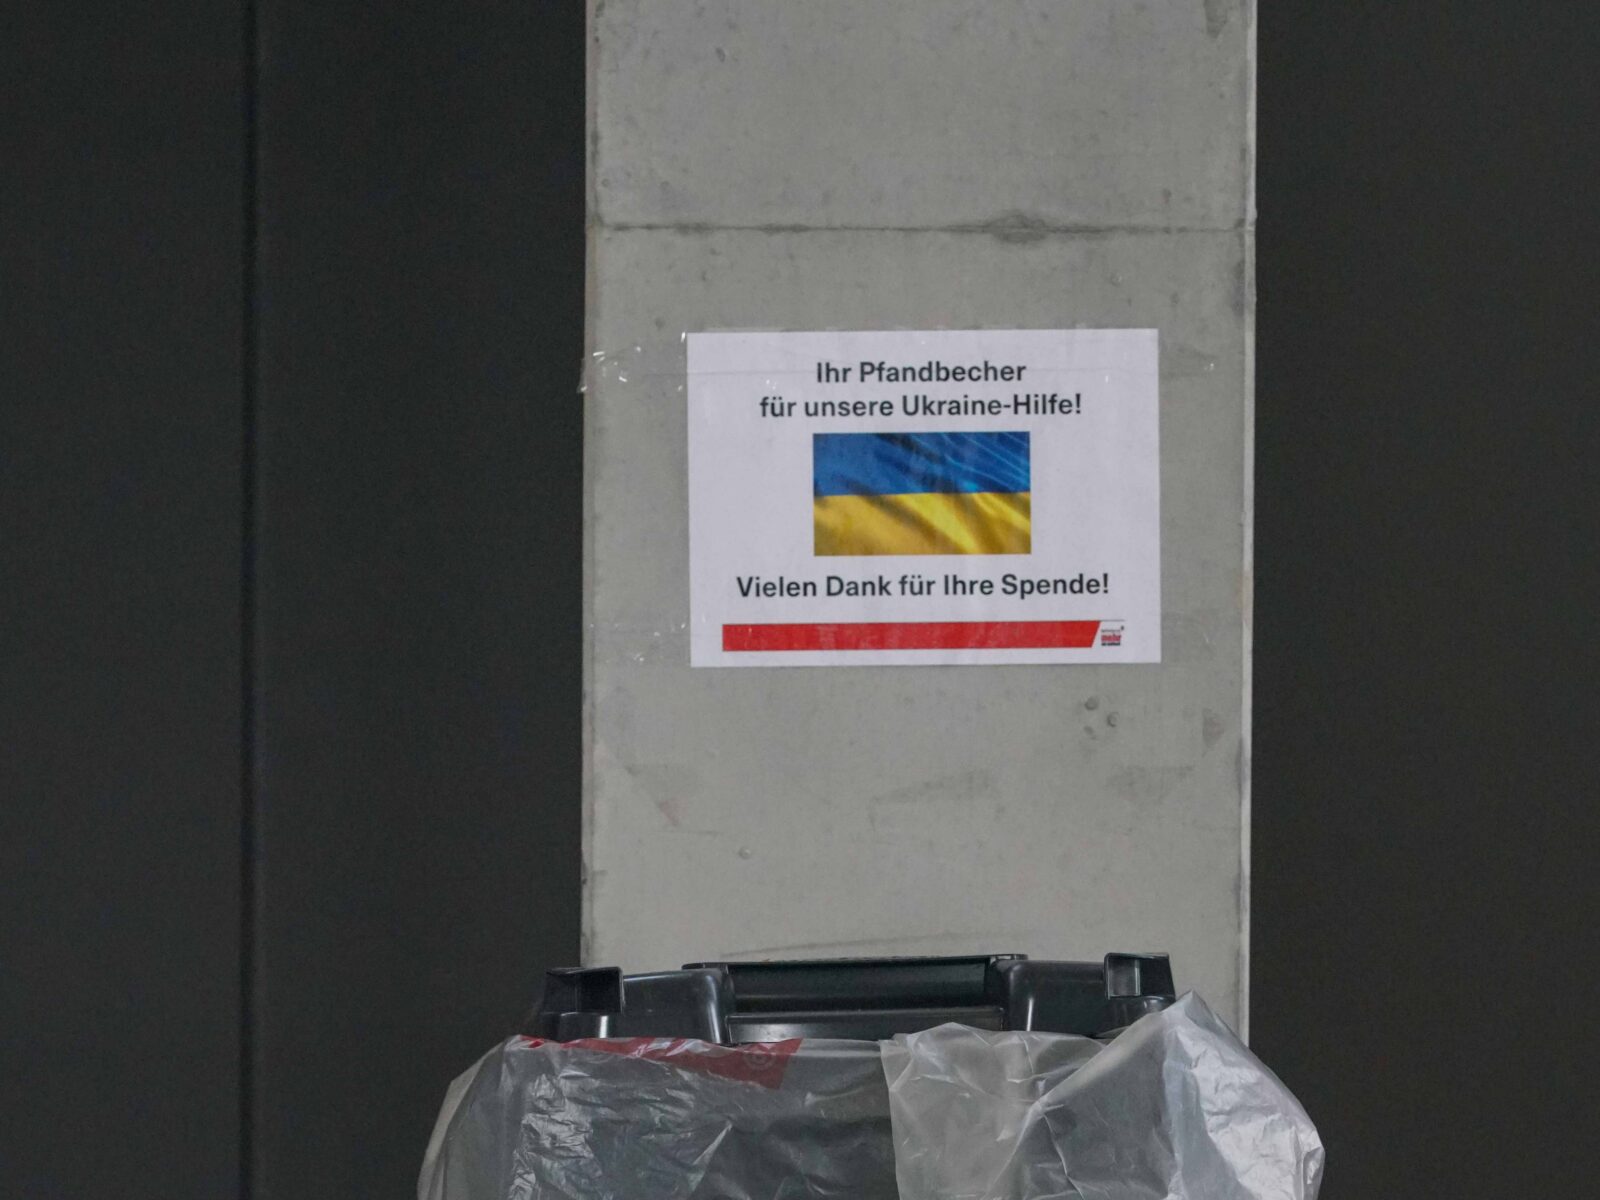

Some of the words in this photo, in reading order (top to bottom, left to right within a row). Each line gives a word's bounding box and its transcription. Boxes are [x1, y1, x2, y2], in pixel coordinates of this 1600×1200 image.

[816, 361, 852, 383] Ihr
[859, 360, 1026, 382] Pfandbecher
[759, 396, 796, 417] für
[804, 400, 893, 417] unsere
[902, 392, 1080, 416] Ukraine-Hilfe!
[736, 575, 816, 597] Vielen
[826, 575, 891, 596] Dank
[898, 574, 935, 595] für
[944, 574, 994, 595] Ihre
[1001, 572, 1108, 600] Spende!
